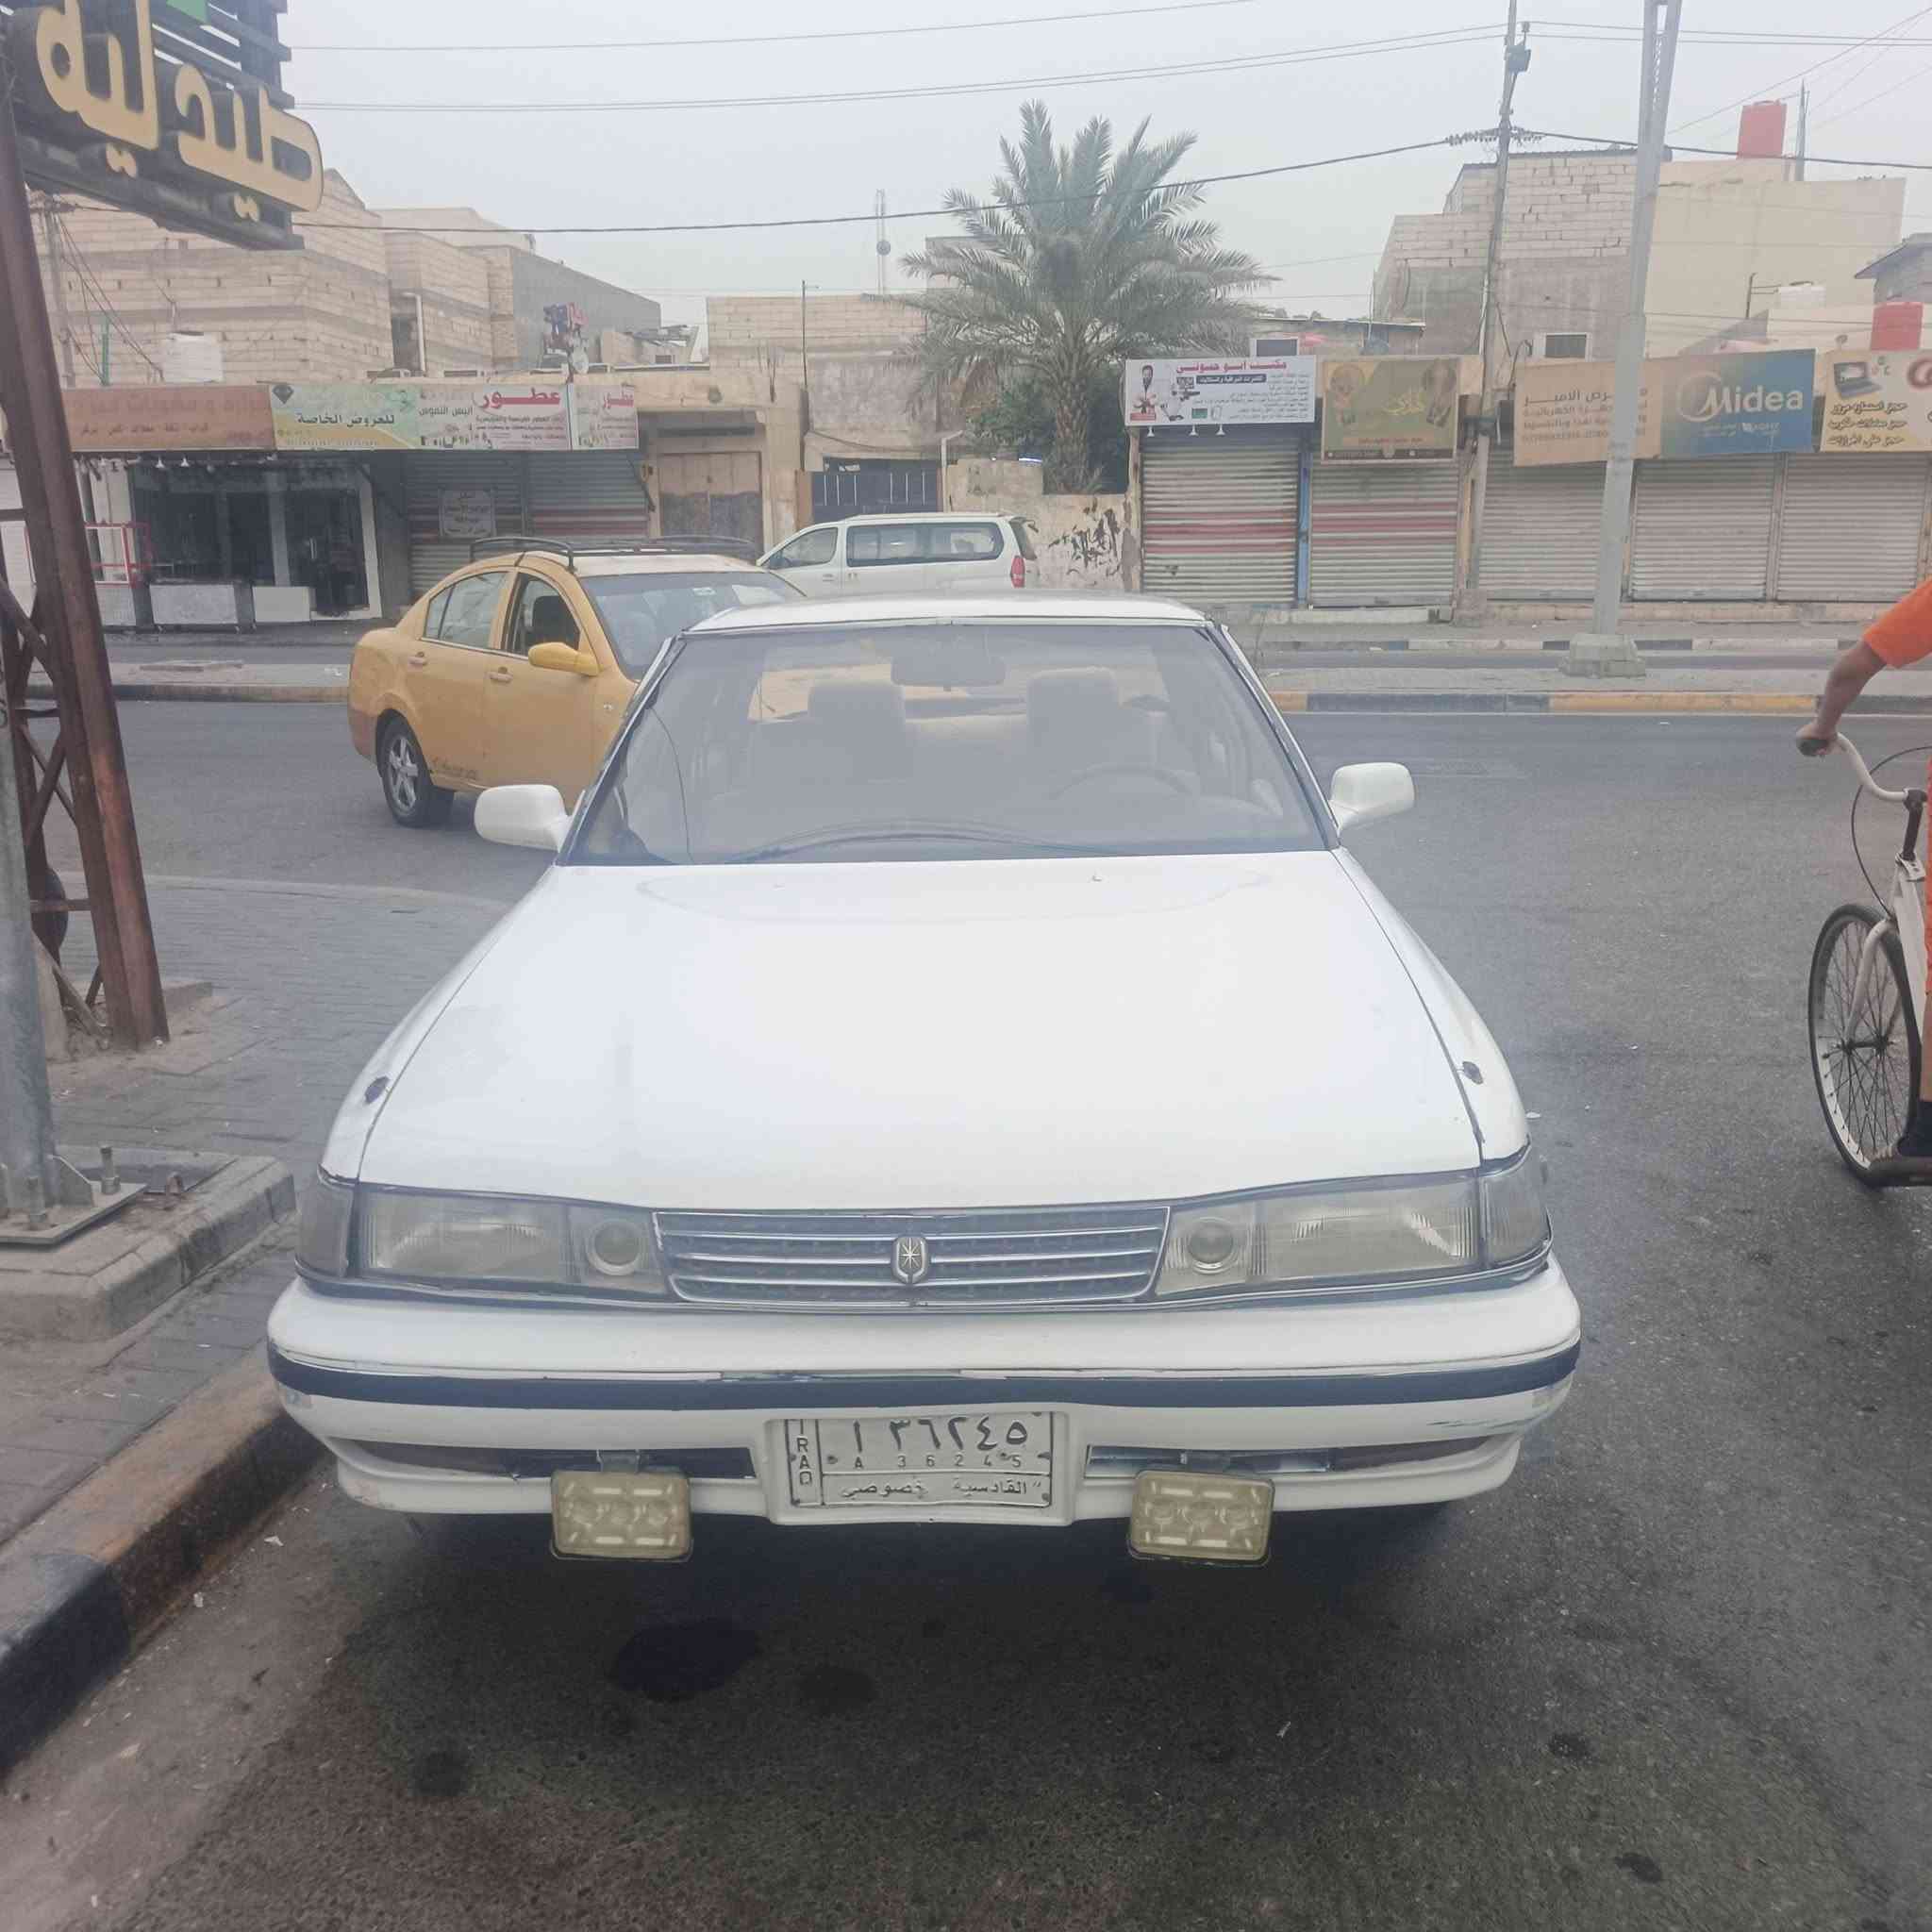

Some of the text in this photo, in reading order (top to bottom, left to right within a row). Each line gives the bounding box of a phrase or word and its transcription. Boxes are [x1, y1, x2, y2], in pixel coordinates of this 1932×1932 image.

[478, 388, 560, 409] عطور
[1695, 385, 1804, 414] Midea
[297, 410, 342, 425] الخاصة
[889, 1415, 1028, 1452] ٣٦٢٤٥
[795, 1419, 813, 1487] IRAQ
[897, 1453, 1022, 1469] 36245
[841, 1477, 1027, 1499] القادسية خصوصي
